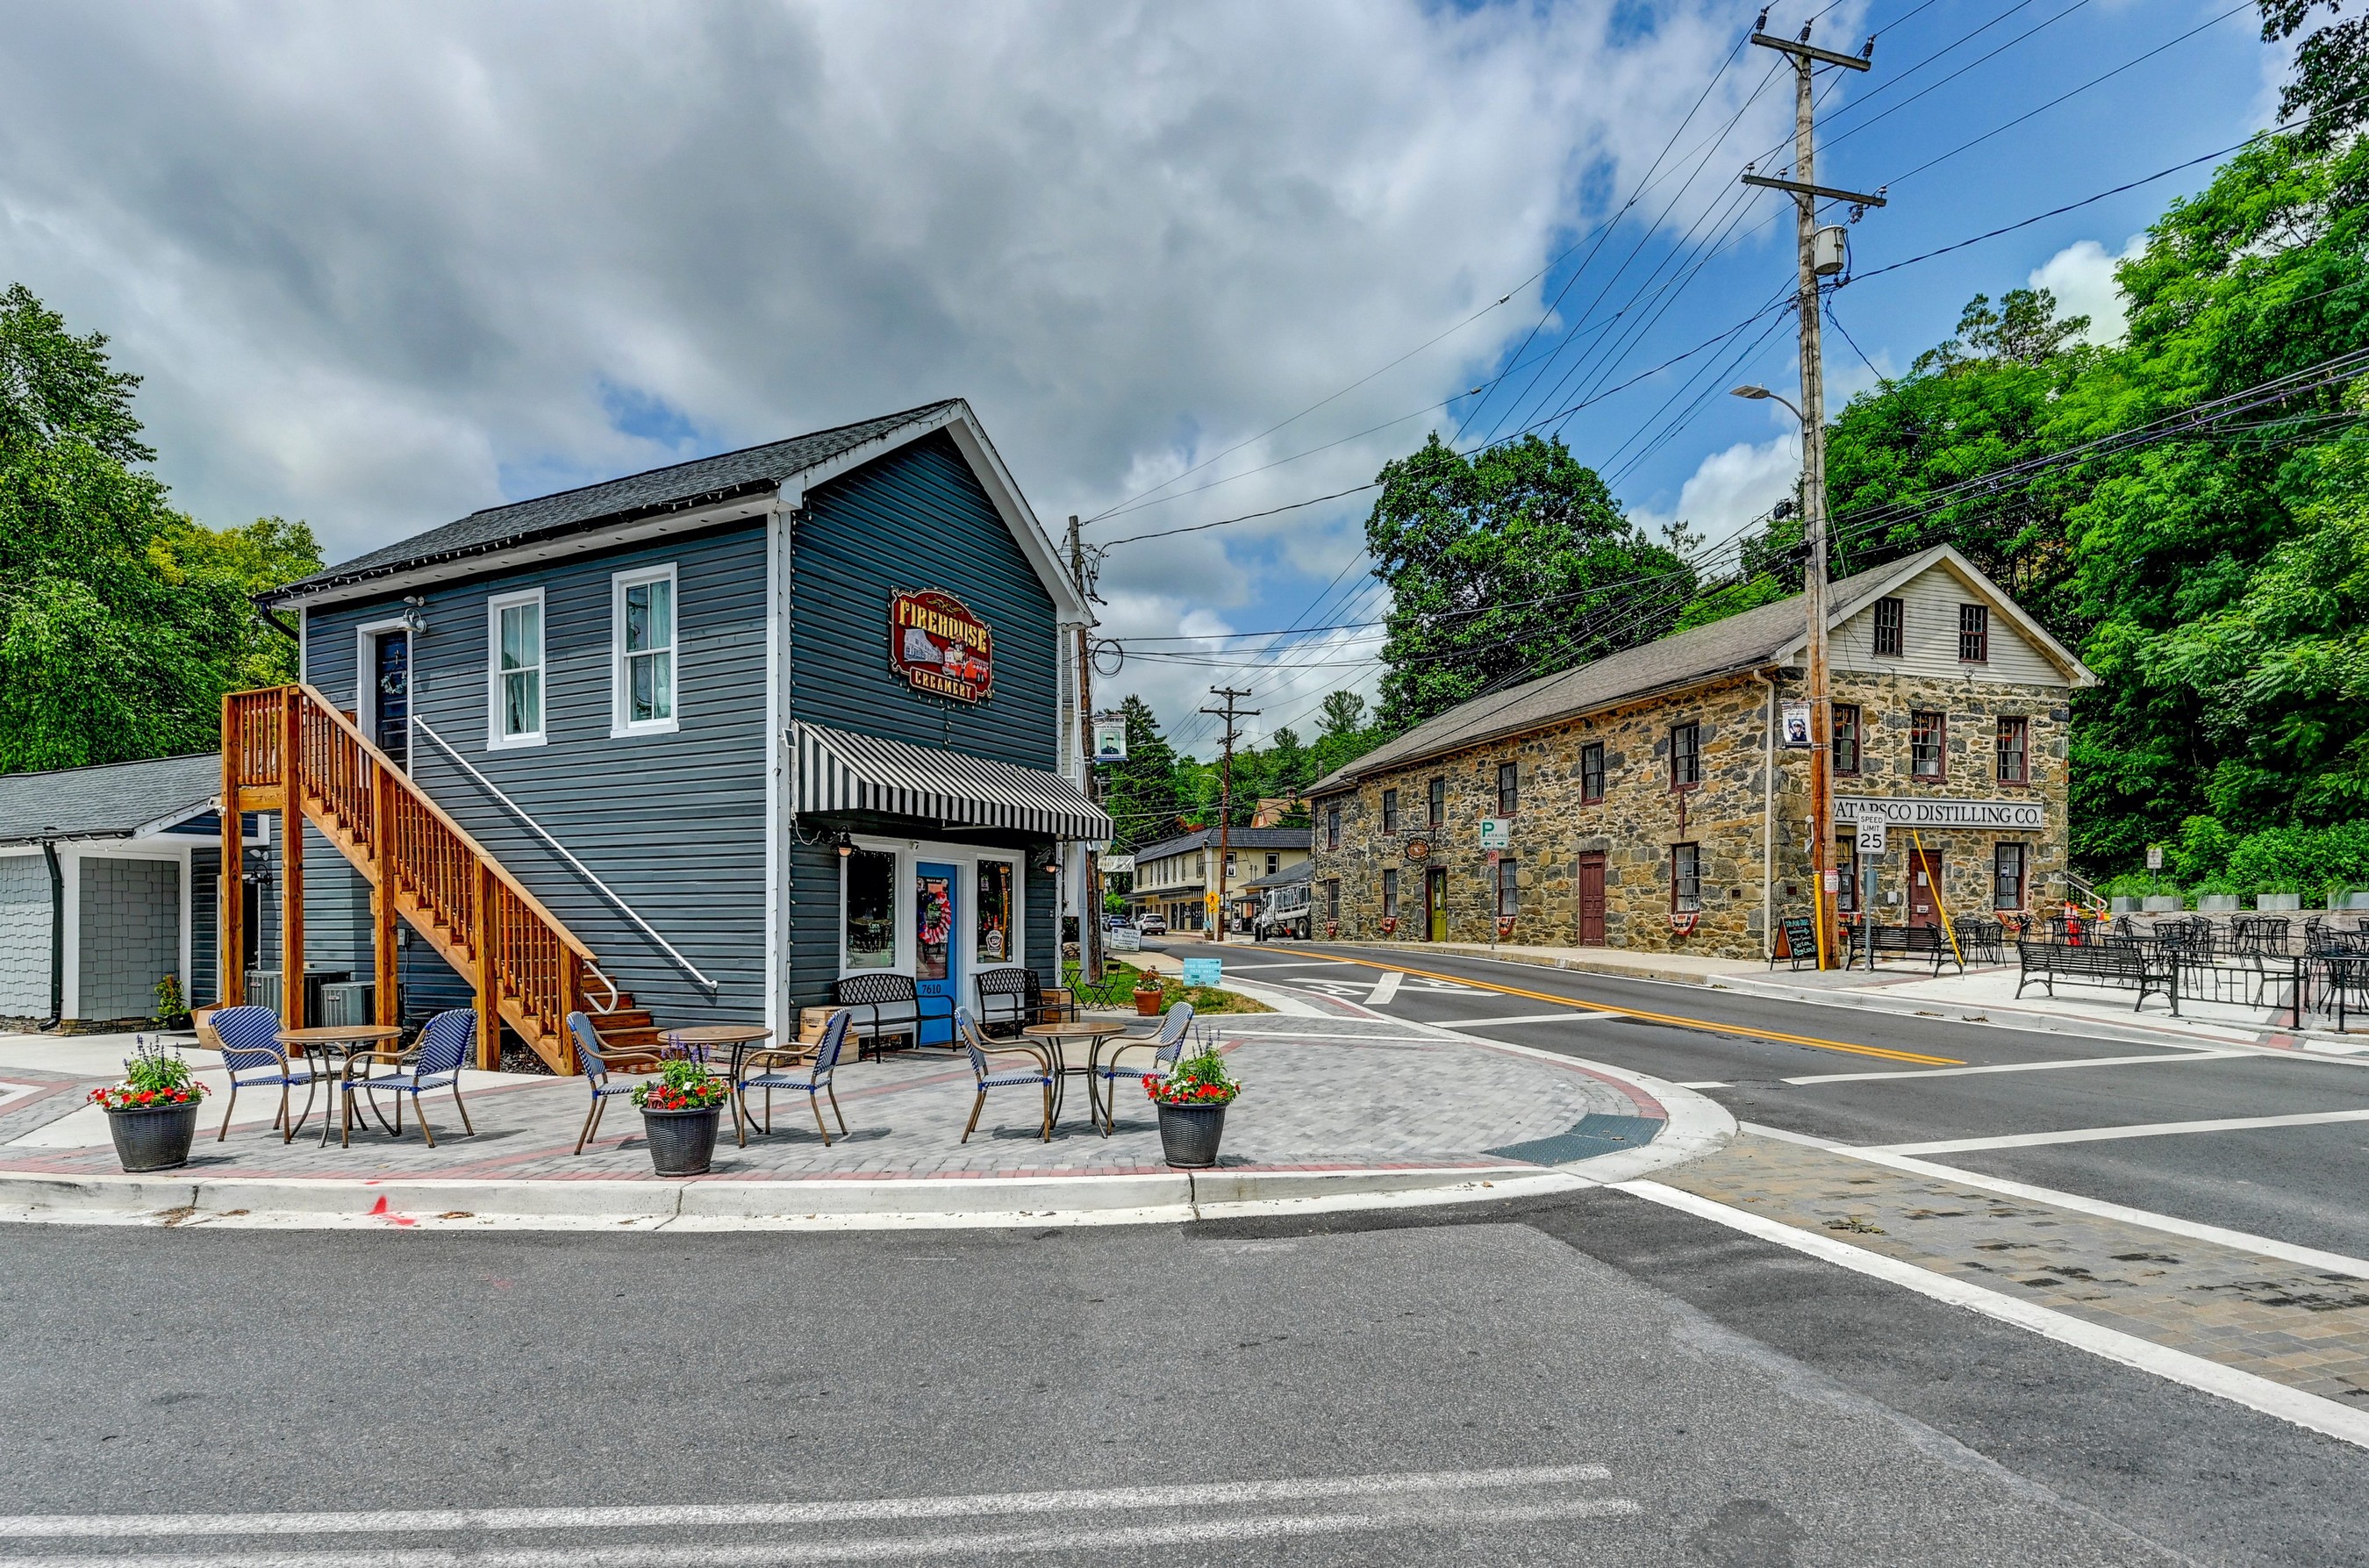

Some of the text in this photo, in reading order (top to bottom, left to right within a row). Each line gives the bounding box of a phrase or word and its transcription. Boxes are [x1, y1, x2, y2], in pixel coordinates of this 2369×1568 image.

[898, 599, 987, 654] FIREHOUSE
[914, 669, 972, 699] CREAMERY
[1834, 801, 2040, 824] ATAPSCO DISTILLING CO.
[1482, 821, 1507, 838] PARKING
[1860, 834, 1882, 848] 25
[922, 984, 941, 994] 7610
